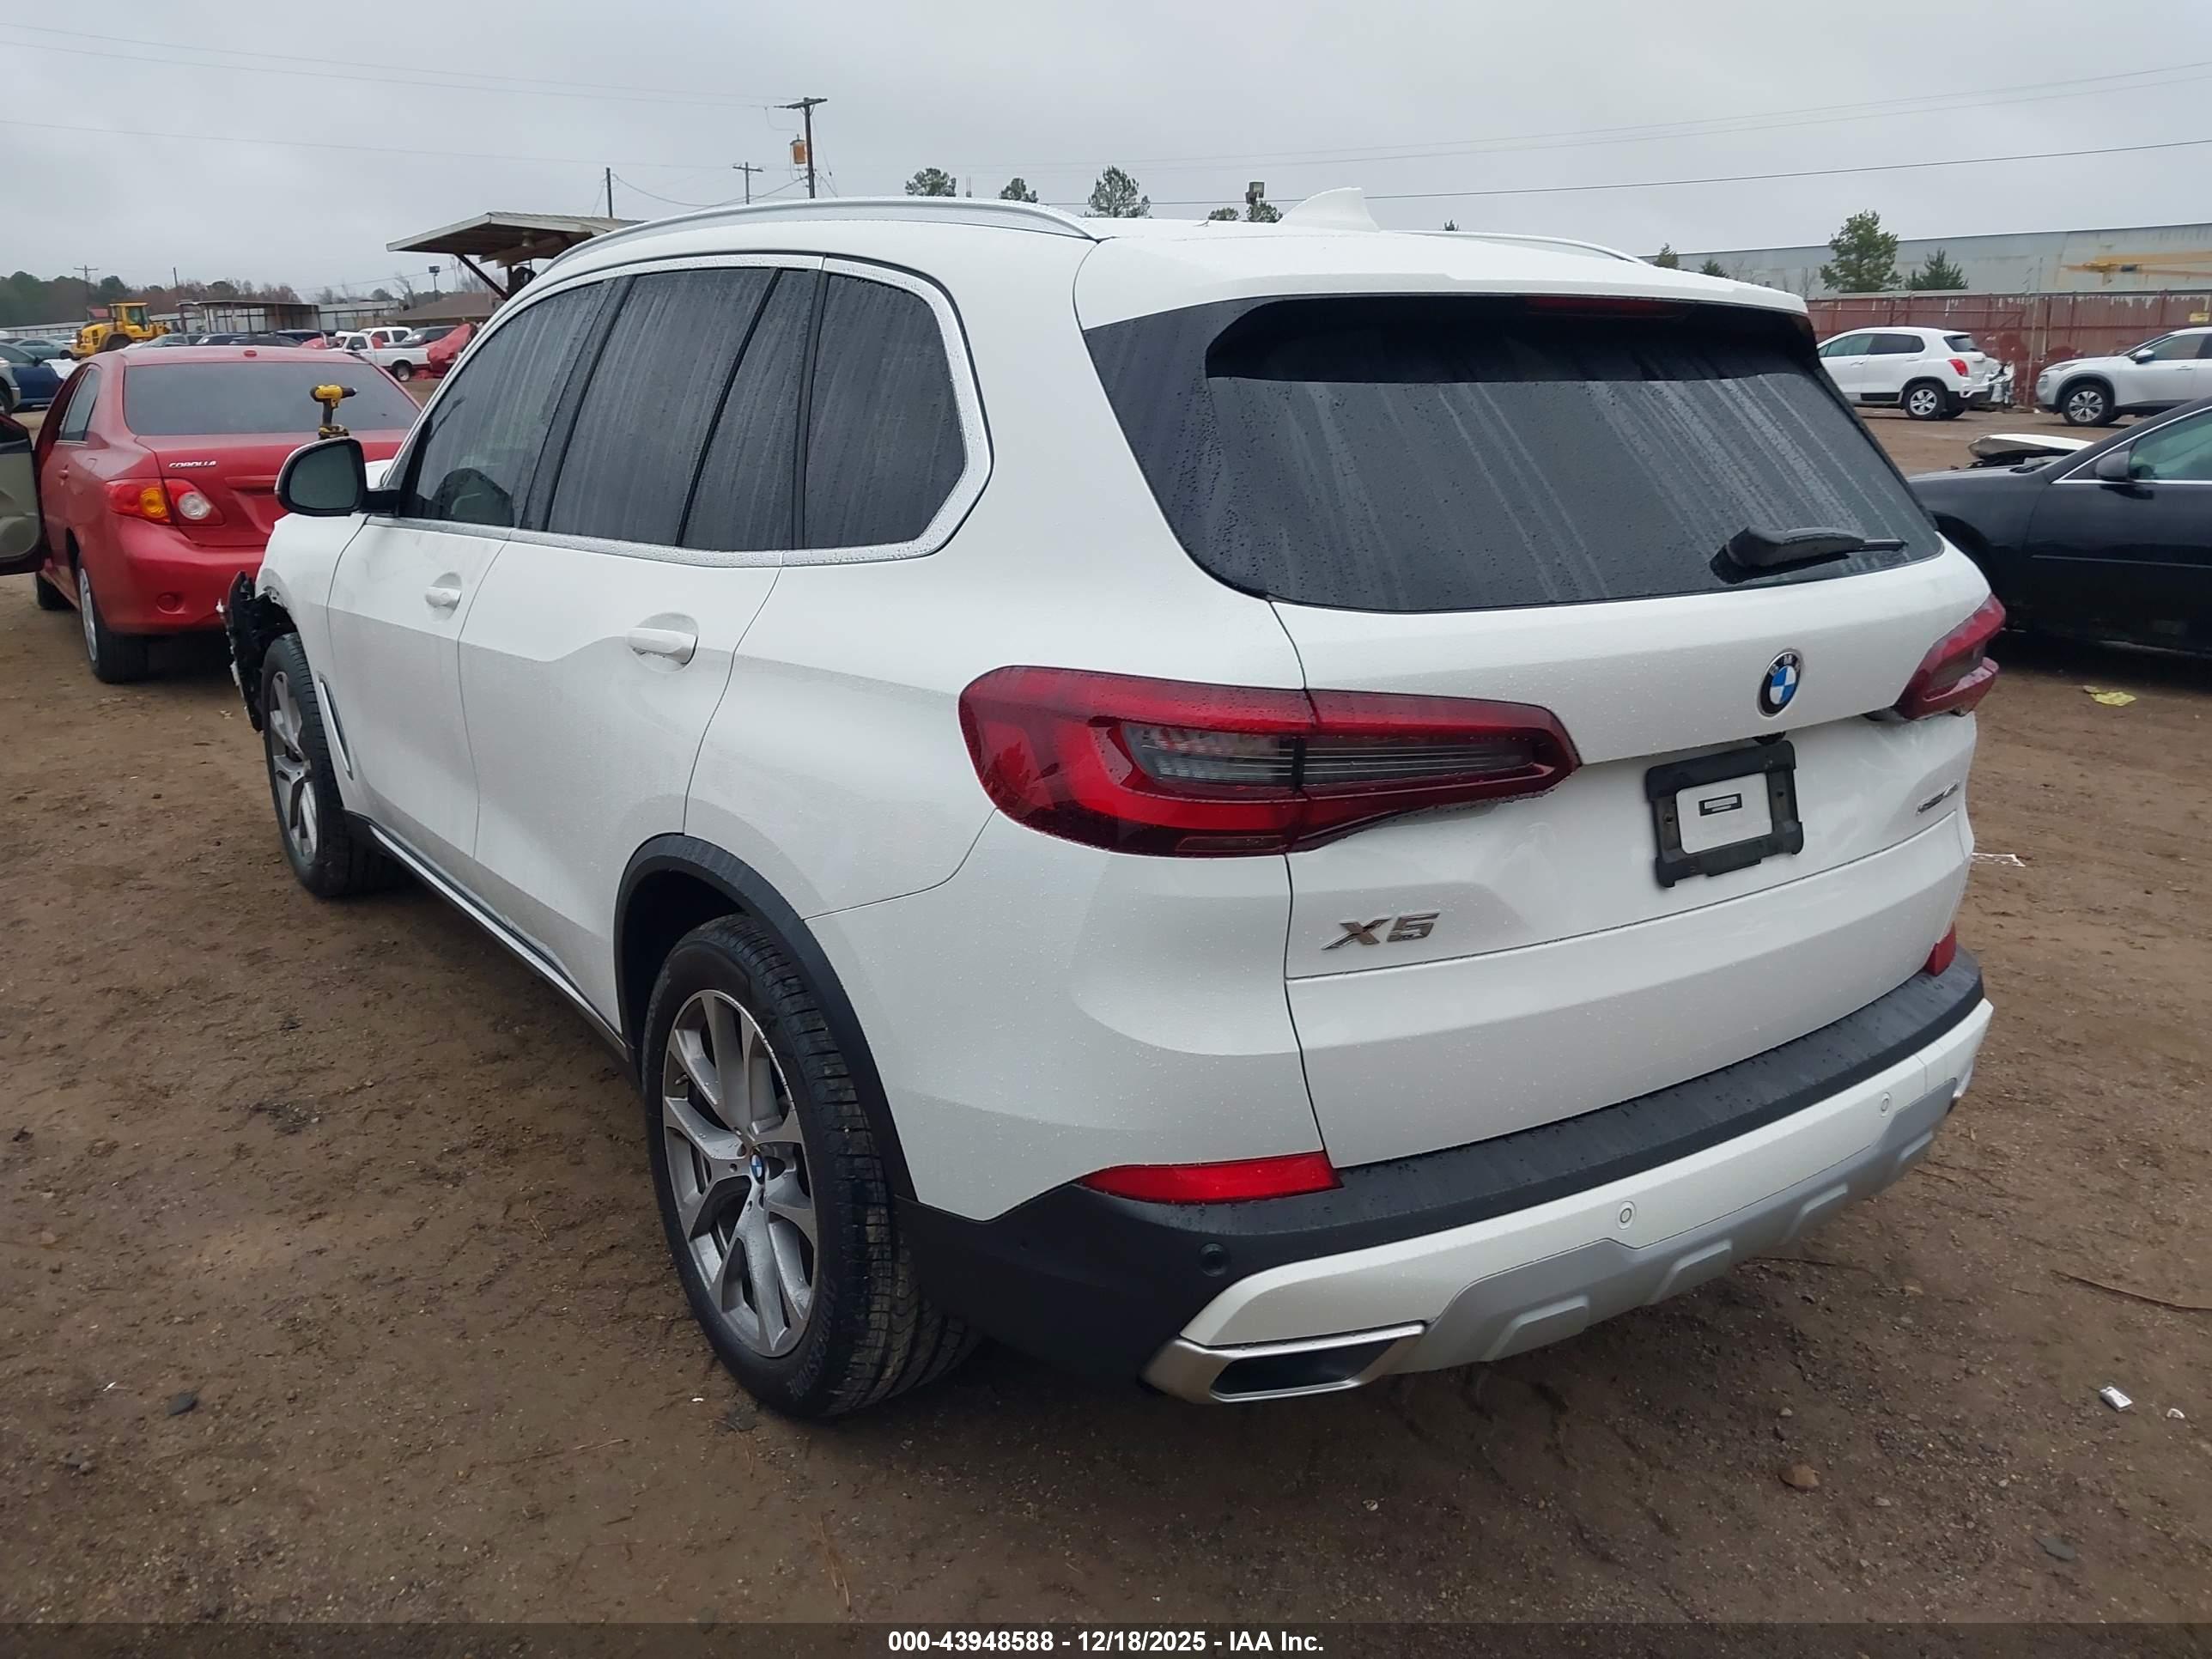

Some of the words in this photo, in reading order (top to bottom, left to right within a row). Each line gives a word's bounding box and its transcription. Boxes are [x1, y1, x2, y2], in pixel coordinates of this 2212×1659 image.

[168, 459, 216, 469] COROLLA
[1768, 653, 1802, 677] BMW
[1321, 909, 1441, 951] X5
